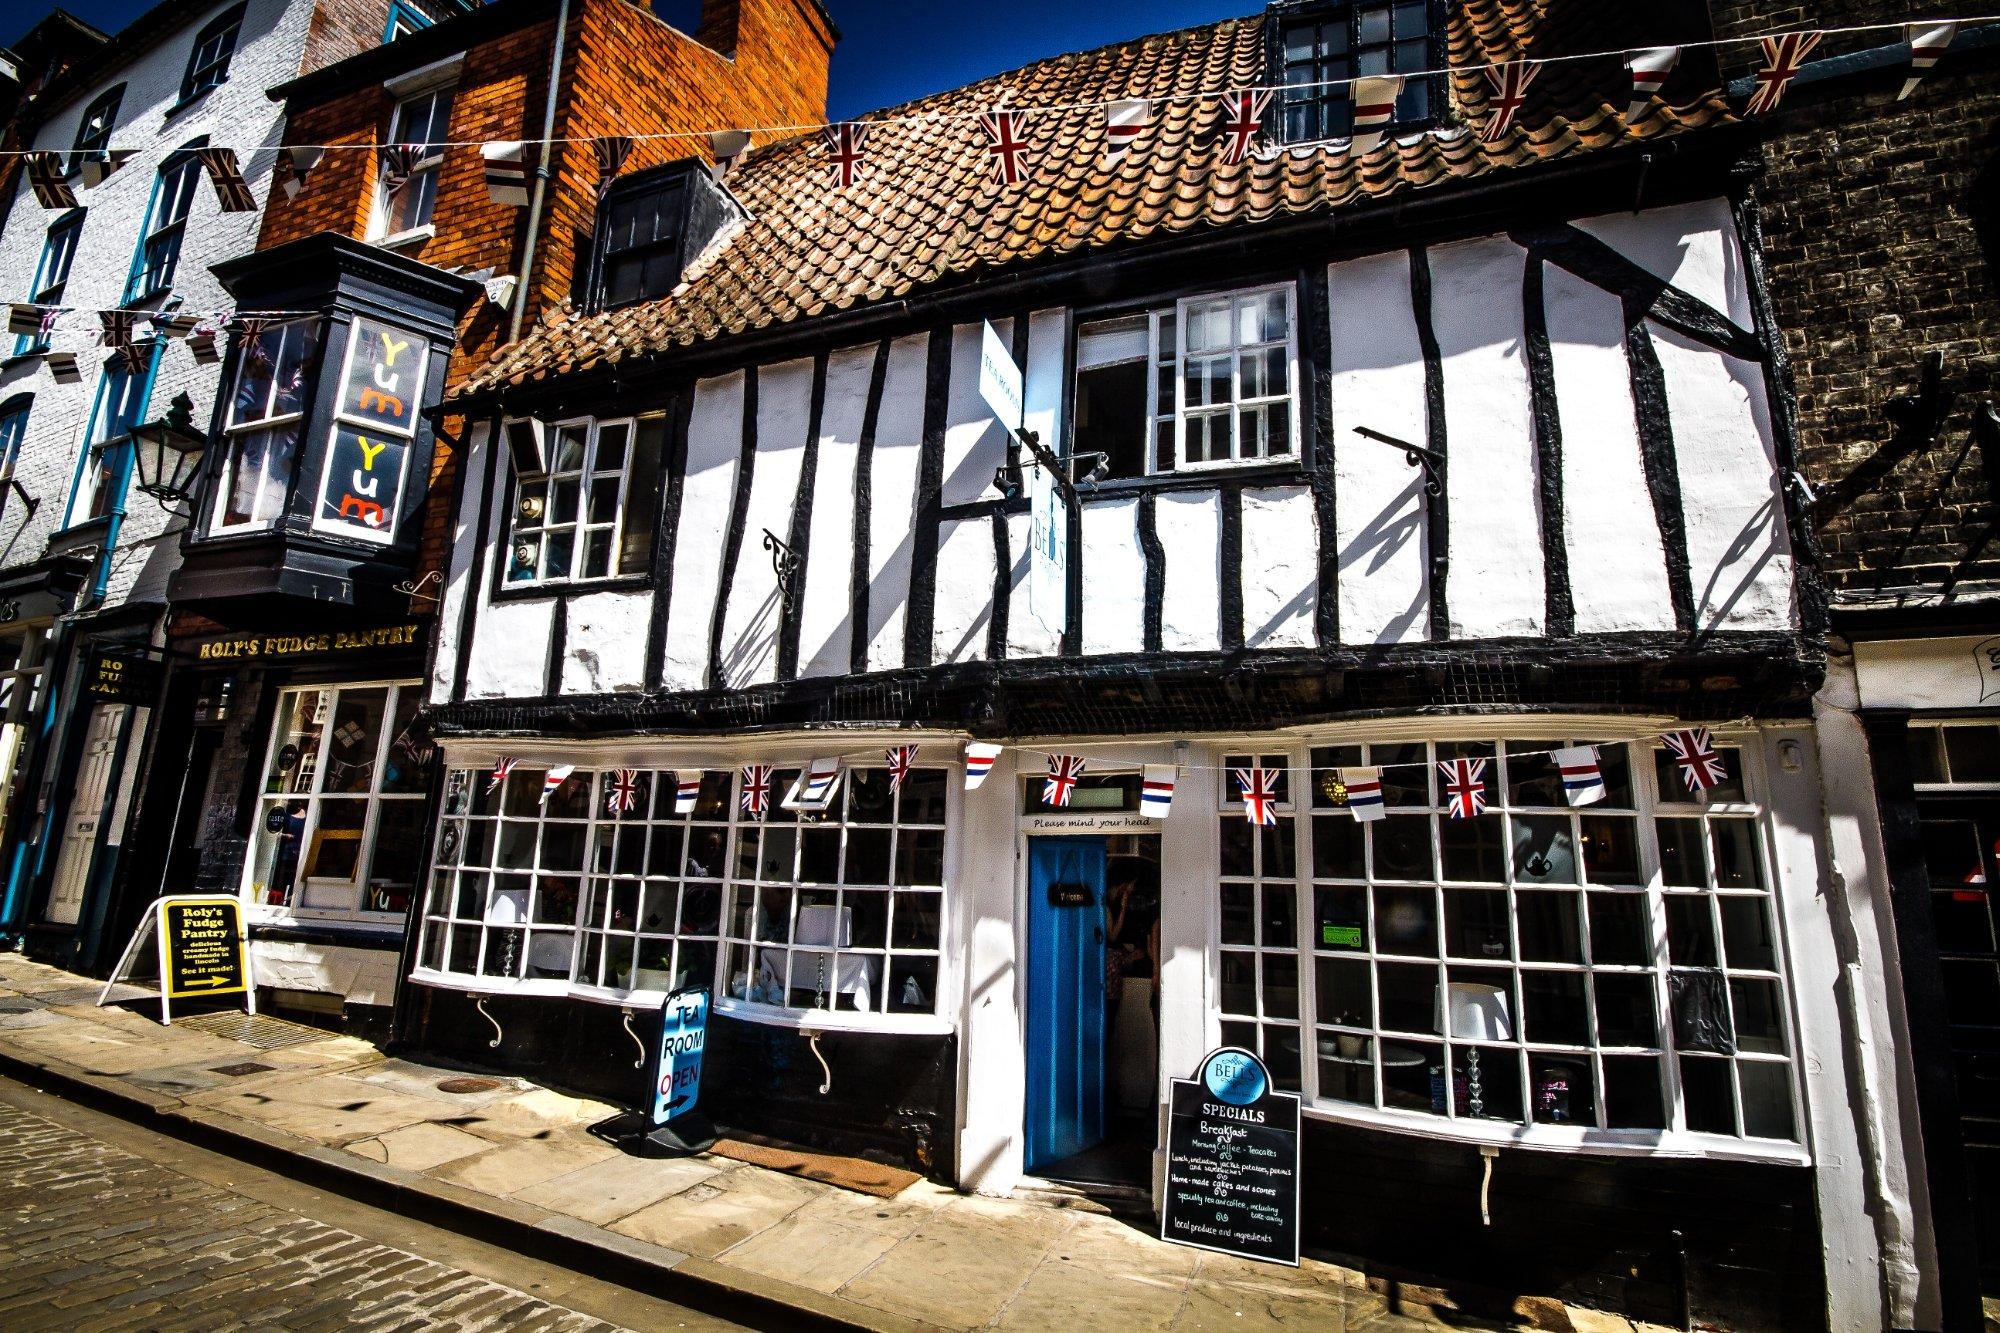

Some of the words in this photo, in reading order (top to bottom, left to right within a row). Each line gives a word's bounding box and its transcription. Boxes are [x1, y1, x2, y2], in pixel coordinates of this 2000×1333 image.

[359, 332, 409, 417] Yum
[338, 435, 386, 523] Yum
[1034, 517, 1064, 570] BES
[199, 638, 260, 659] ROLY'S
[264, 632, 331, 654] FUDGE
[334, 624, 419, 649] PANTRY
[1033, 819, 1066, 828] Please
[1068, 819, 1096, 827] mind
[1098, 819, 1122, 829] your
[1124, 817, 1151, 827] head
[182, 907, 223, 918] Roly's
[183, 918, 224, 929] Fudge
[181, 929, 228, 939] Pantry
[184, 952, 220, 960] handmade
[181, 967, 197, 975] See
[198, 966, 206, 974] it
[207, 964, 234, 973] made!
[676, 1004, 699, 1027] TEA
[663, 1029, 704, 1059] ROOM
[660, 1062, 699, 1095] OPEN
[1215, 1063, 1256, 1080] BELLS
[1203, 1103, 1265, 1123] SPECIALS
[1200, 1121, 1248, 1138] Breakfast
[1192, 1139, 1217, 1154] Morning
[1217, 1143, 1241, 1154] Coffee
[1247, 1145, 1277, 1157] Teacakes
[1212, 1178, 1234, 1190] cakes
[1236, 1183, 1250, 1192] and
[1251, 1186, 1277, 1196] scones
[1204, 1195, 1215, 1204] tea
[1250, 1203, 1279, 1216] including
[1174, 1216, 1190, 1230] local
[1190, 1222, 1217, 1234] produce
[1218, 1228, 1232, 1237] and
[1233, 1231, 1273, 1243] ingredients
